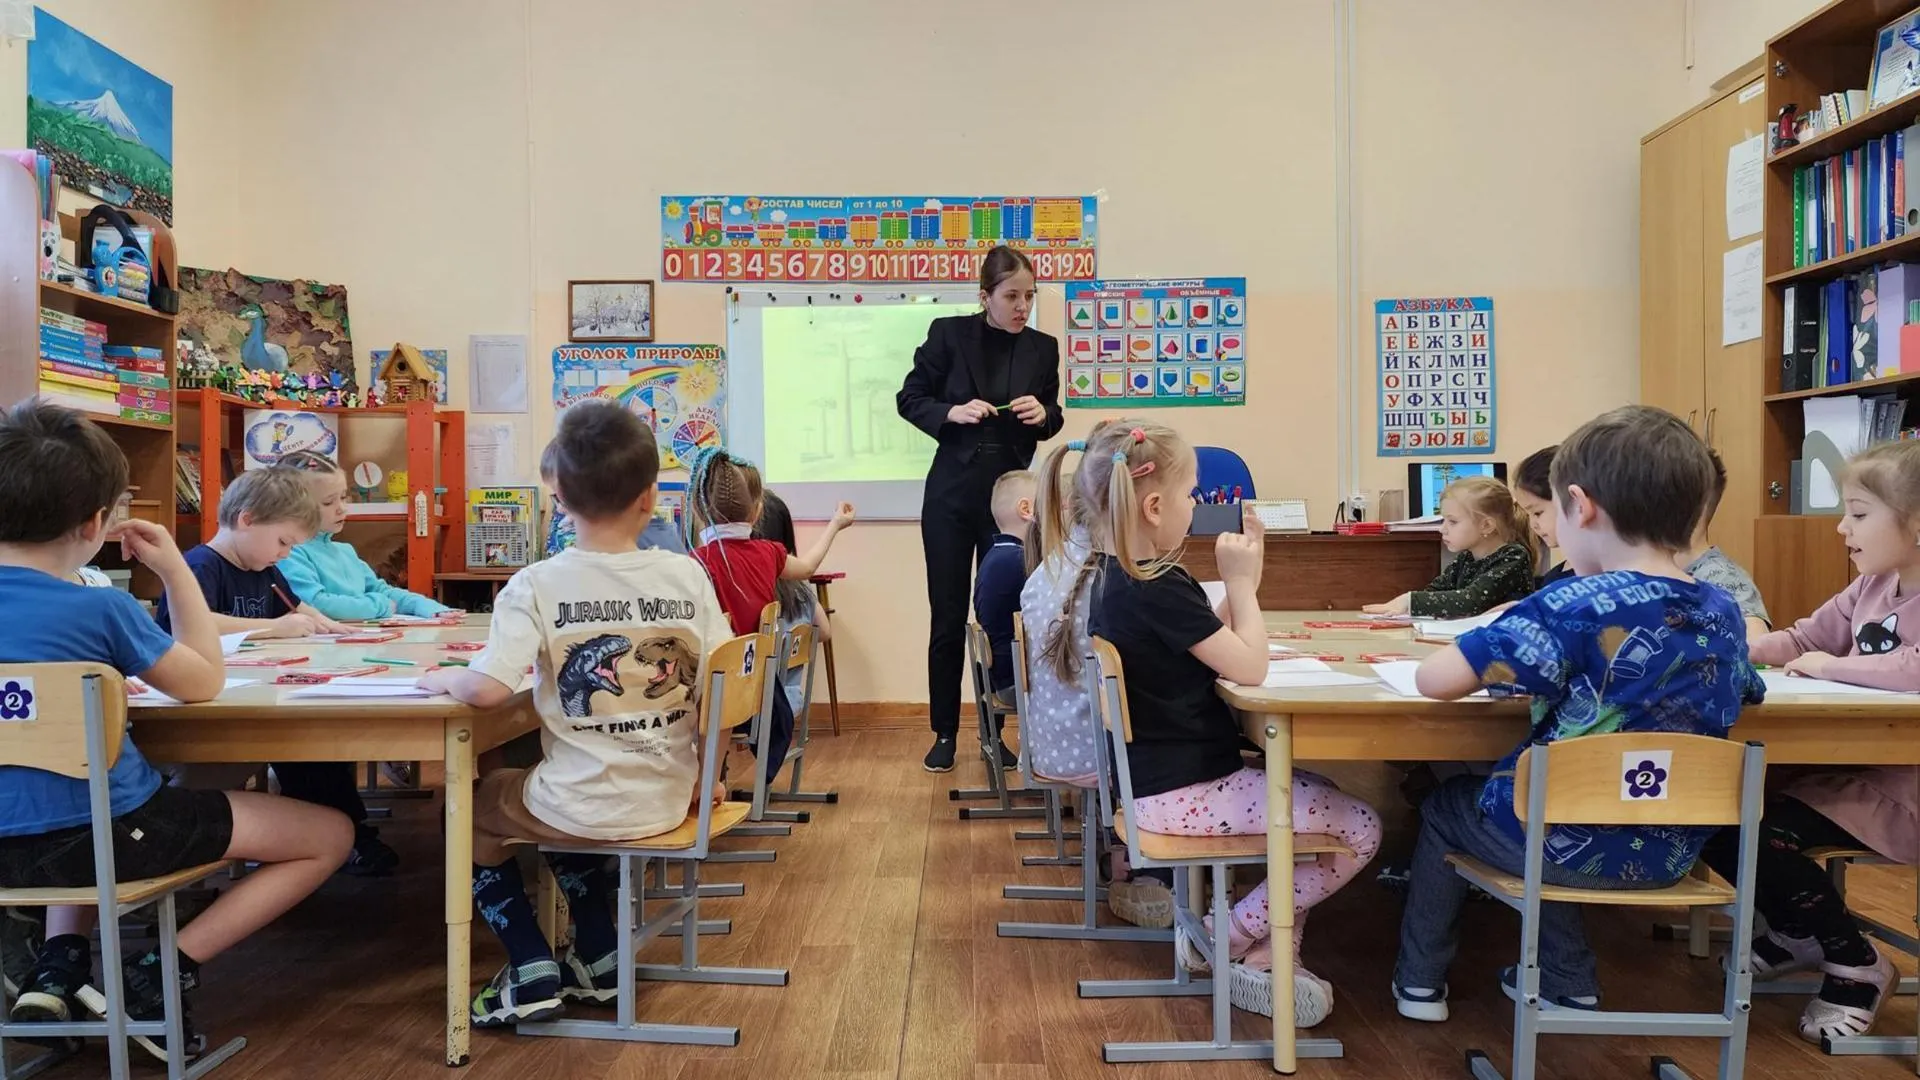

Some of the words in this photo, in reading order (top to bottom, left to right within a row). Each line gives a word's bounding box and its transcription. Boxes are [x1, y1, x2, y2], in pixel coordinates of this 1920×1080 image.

[763, 199, 804, 208] СОСТАВ
[806, 199, 843, 208] ЧИСЕЛ
[876, 201, 888, 209] до
[891, 199, 903, 208] 10
[665, 253, 682, 277] 0
[689, 253, 699, 277] 1
[706, 253, 723, 277] 2
[727, 253, 743, 277] 3
[746, 253, 764, 277] 4
[768, 253, 784, 277] 5
[787, 253, 805, 277] 6
[809, 254, 824, 277] 7
[828, 254, 846, 278] 8
[850, 254, 867, 278] 9
[869, 254, 888, 278] 10
[890, 254, 908, 278] 11
[910, 254, 930, 278] 12
[930, 254, 950, 278] 13
[951, 254, 970, 278] 14
[1034, 253, 1053, 277] 18
[1054, 253, 1074, 277] 19
[1075, 253, 1094, 277] 20
[1395, 298, 1475, 312] АЗБУКА
[1385, 316, 1398, 329] А
[1407, 316, 1418, 328] Б
[1429, 315, 1440, 328] В
[1450, 314, 1460, 327] Г
[1471, 313, 1485, 329] Д
[1387, 336, 1397, 349] Е
[1408, 333, 1419, 348] Ё
[1427, 336, 1444, 348] Ж
[1452, 335, 1462, 348] З
[1472, 334, 1485, 346] И
[558, 348, 628, 360] УГОЛОК
[635, 347, 721, 360] ПРИРОДЫ
[1386, 353, 1398, 369] Й
[1408, 356, 1420, 368] К
[1428, 355, 1442, 368] Л
[1450, 354, 1464, 367] М
[1472, 354, 1486, 366] Н
[1386, 375, 1399, 388] О
[1408, 374, 1421, 387] П
[1431, 374, 1442, 386] Р
[1452, 373, 1464, 386] С
[1474, 372, 1486, 385] Т
[1387, 394, 1400, 408] У
[1408, 393, 1423, 406] Ф
[1431, 393, 1444, 406] Х
[1452, 392, 1466, 408] Ц
[1474, 392, 1486, 404] Ч
[1385, 413, 1402, 426] Ш
[1407, 413, 1424, 428] Щ
[1430, 412, 1445, 425] Ъ
[1452, 412, 1466, 424] Ы
[1476, 411, 1486, 424] Ь
[1410, 434, 1422, 446] Э
[1428, 433, 1446, 446] Ю
[1452, 432, 1464, 445] Я
[485, 491, 512, 499] МИР
[1590, 592, 1616, 615] IS
[555, 600, 633, 628] JURASSIC
[638, 598, 696, 621] WORLD
[8, 694, 20, 708] 2
[608, 719, 647, 733] FINS
[652, 717, 662, 728] A
[1639, 772, 1652, 786] 2
